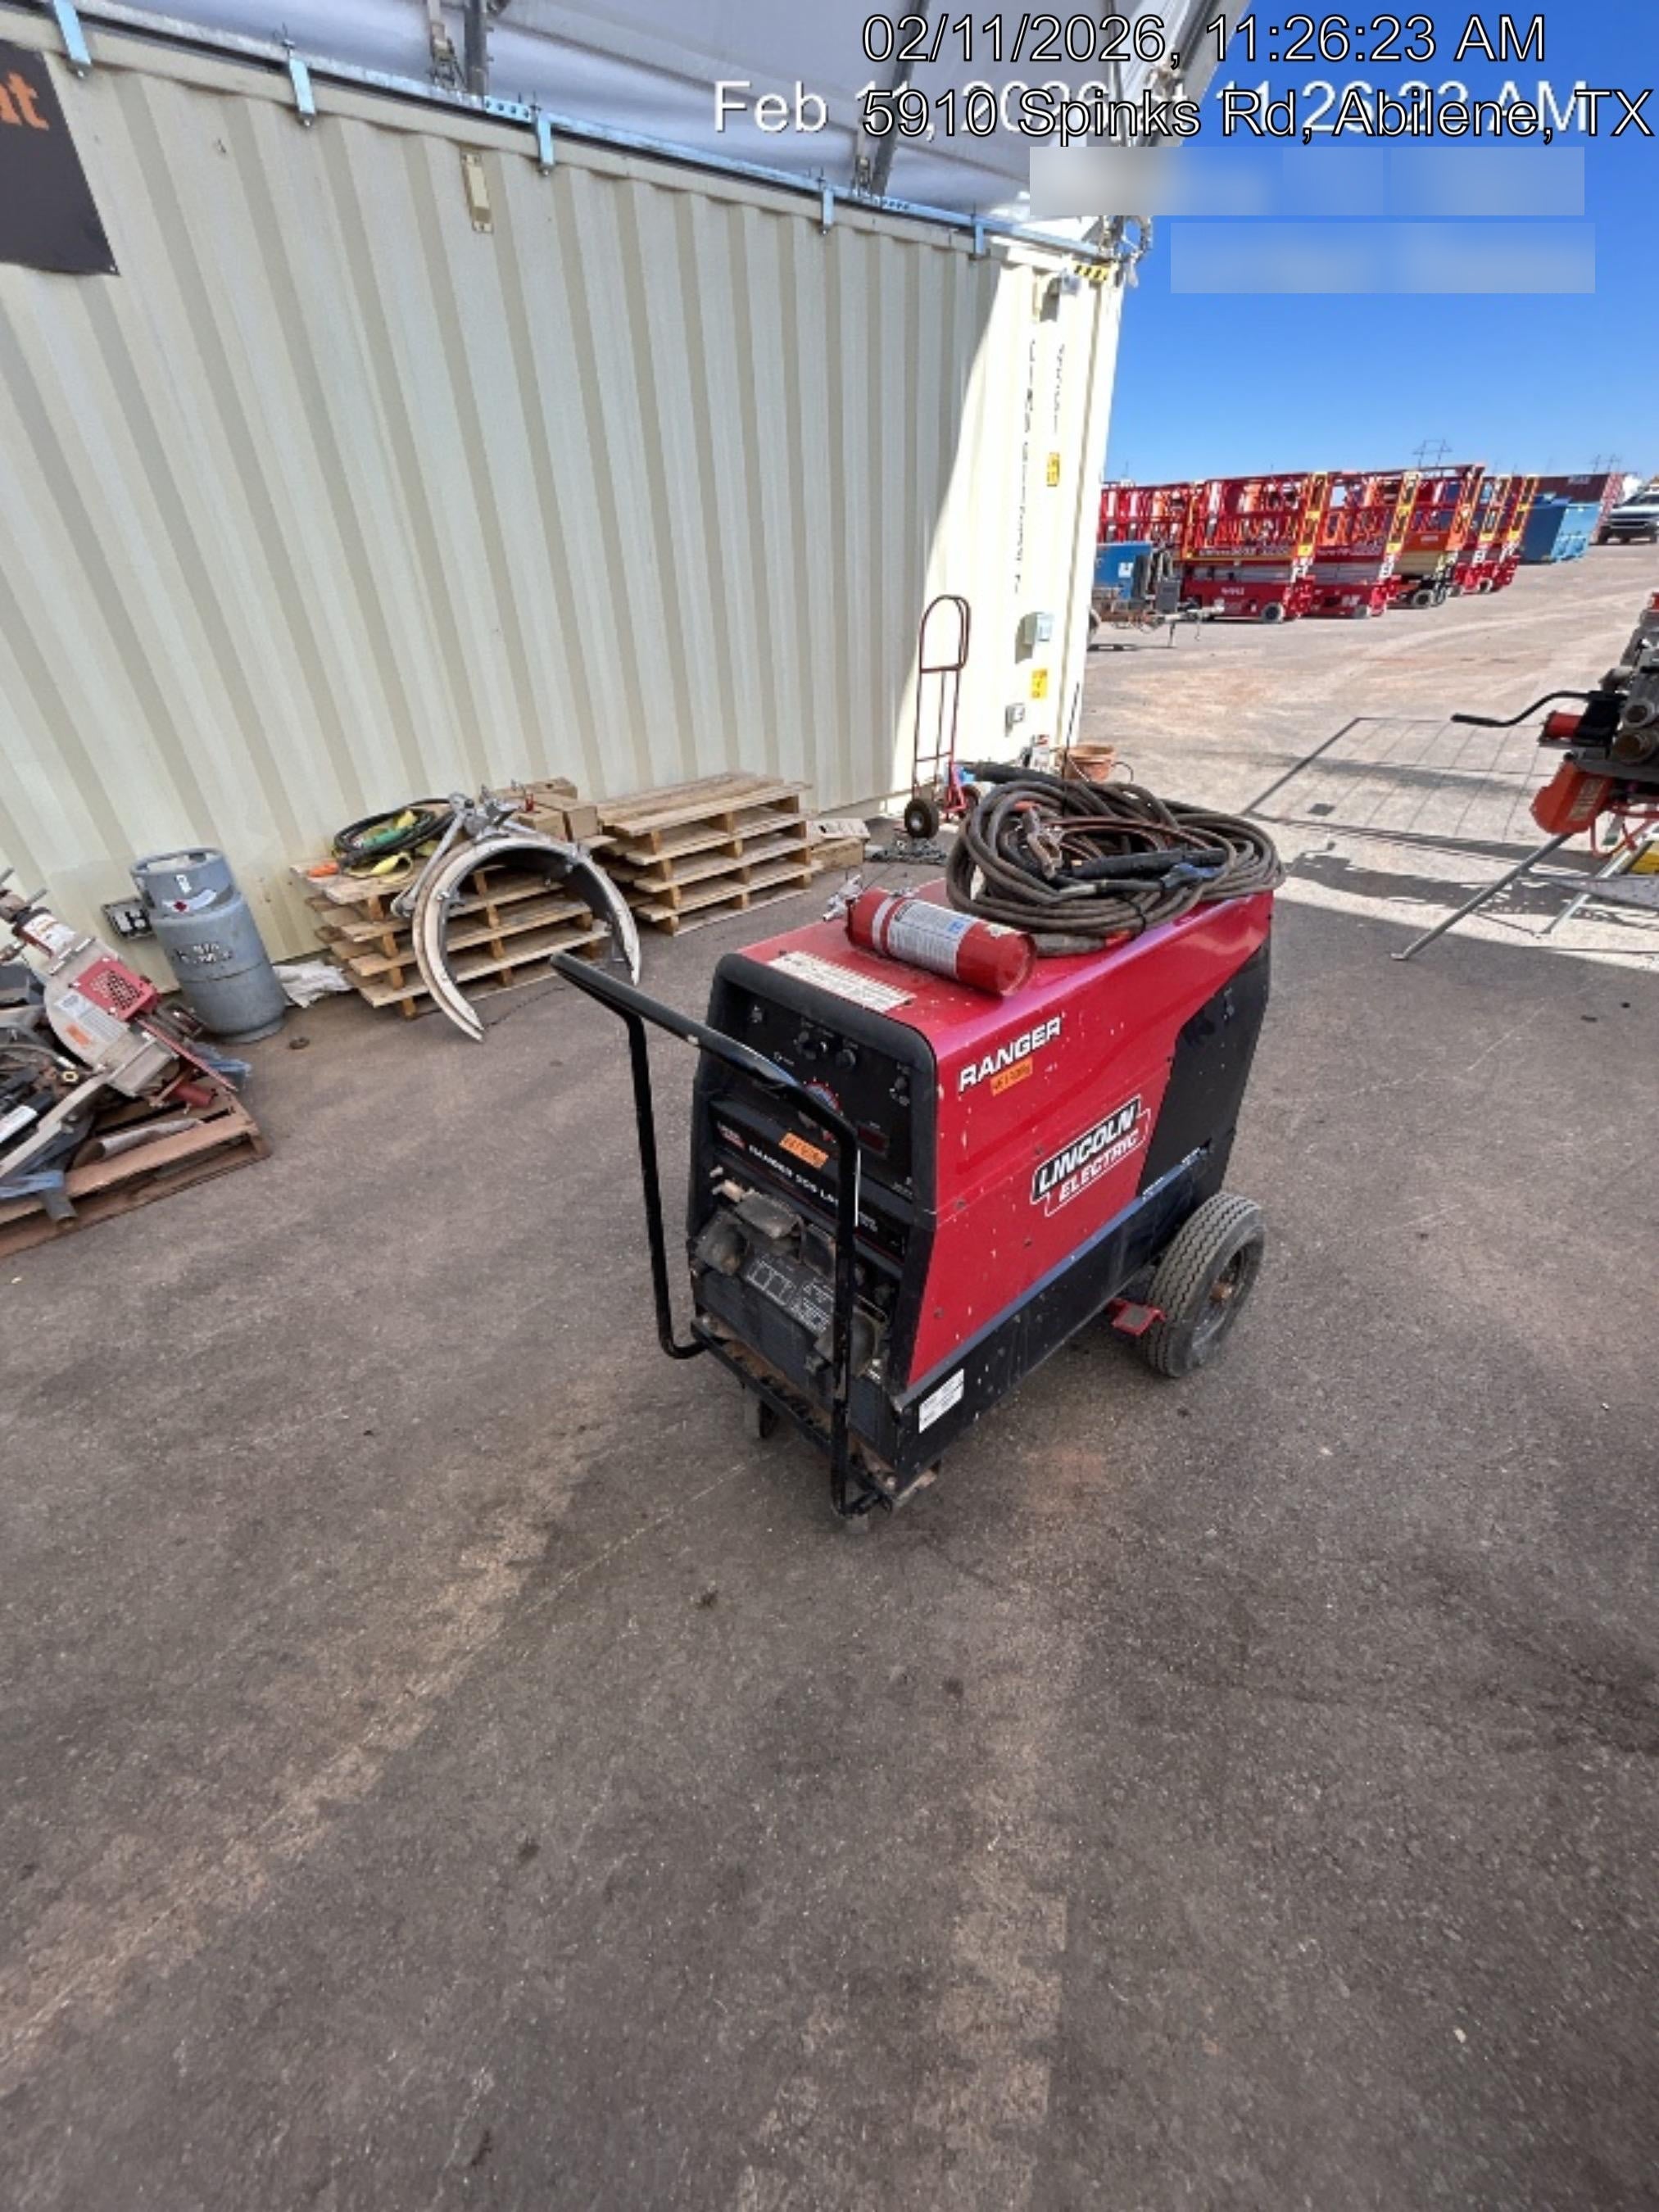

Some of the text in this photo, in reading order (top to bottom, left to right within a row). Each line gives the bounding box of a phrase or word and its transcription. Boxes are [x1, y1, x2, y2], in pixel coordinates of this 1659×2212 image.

[957, 1016, 1061, 1093] RANGER
[1038, 1104, 1137, 1194] LINCOLN
[1058, 1126, 1139, 1203] ELECTRIC
